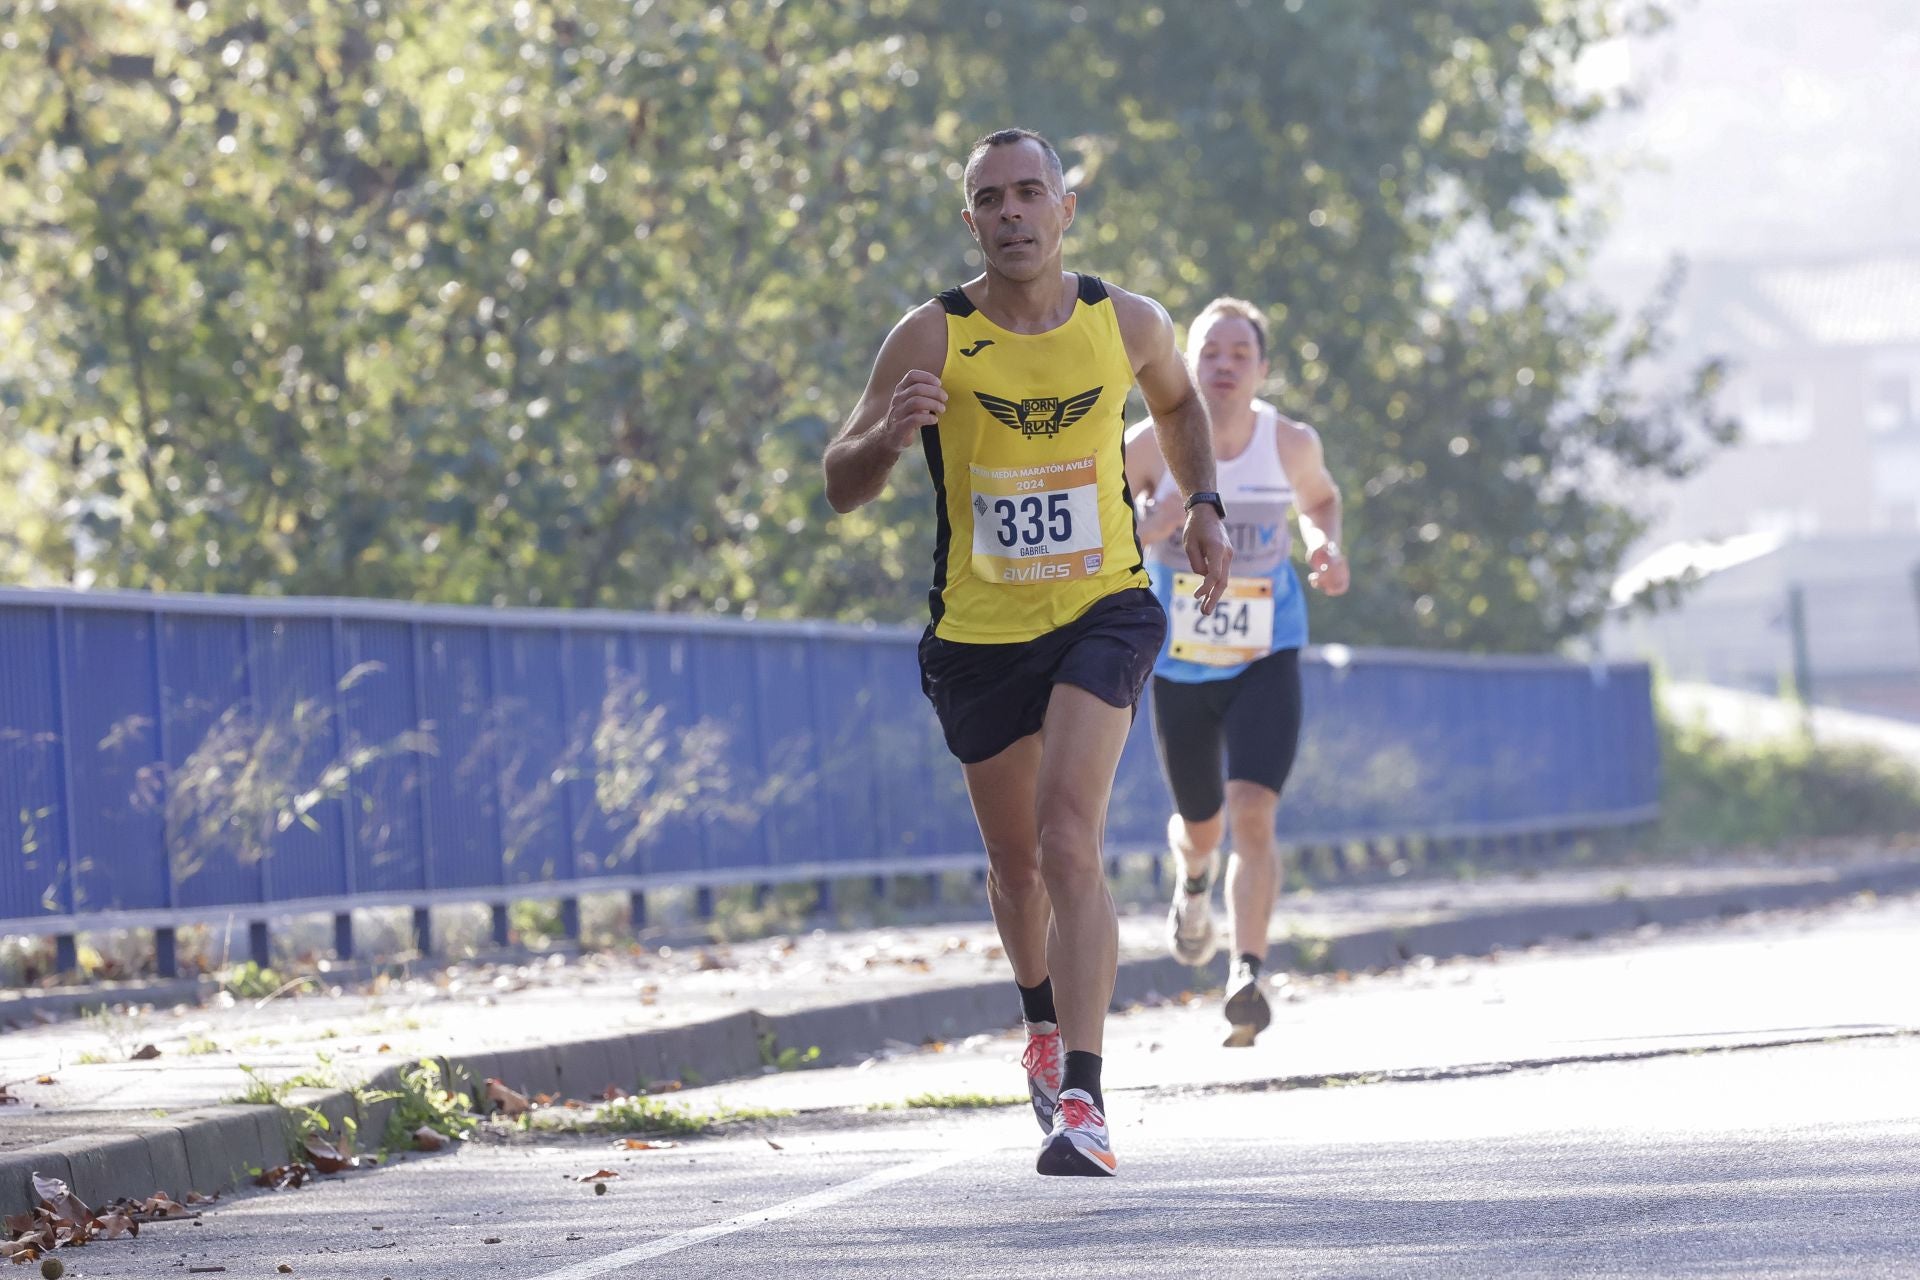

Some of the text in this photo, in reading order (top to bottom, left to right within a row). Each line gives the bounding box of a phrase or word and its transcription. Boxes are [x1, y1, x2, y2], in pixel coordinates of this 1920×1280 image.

[1024, 400, 1056, 412] BORN
[1025, 421, 1056, 434] RUN
[991, 471, 1019, 480] MEDIA
[1020, 463, 1065, 477] MARATÓN
[1066, 459, 1094, 471] AVILÉS
[1016, 480, 1045, 491] 2024
[994, 493, 1072, 547] 335
[1020, 545, 1050, 557] GABRIEL
[1193, 600, 1250, 637] 254
